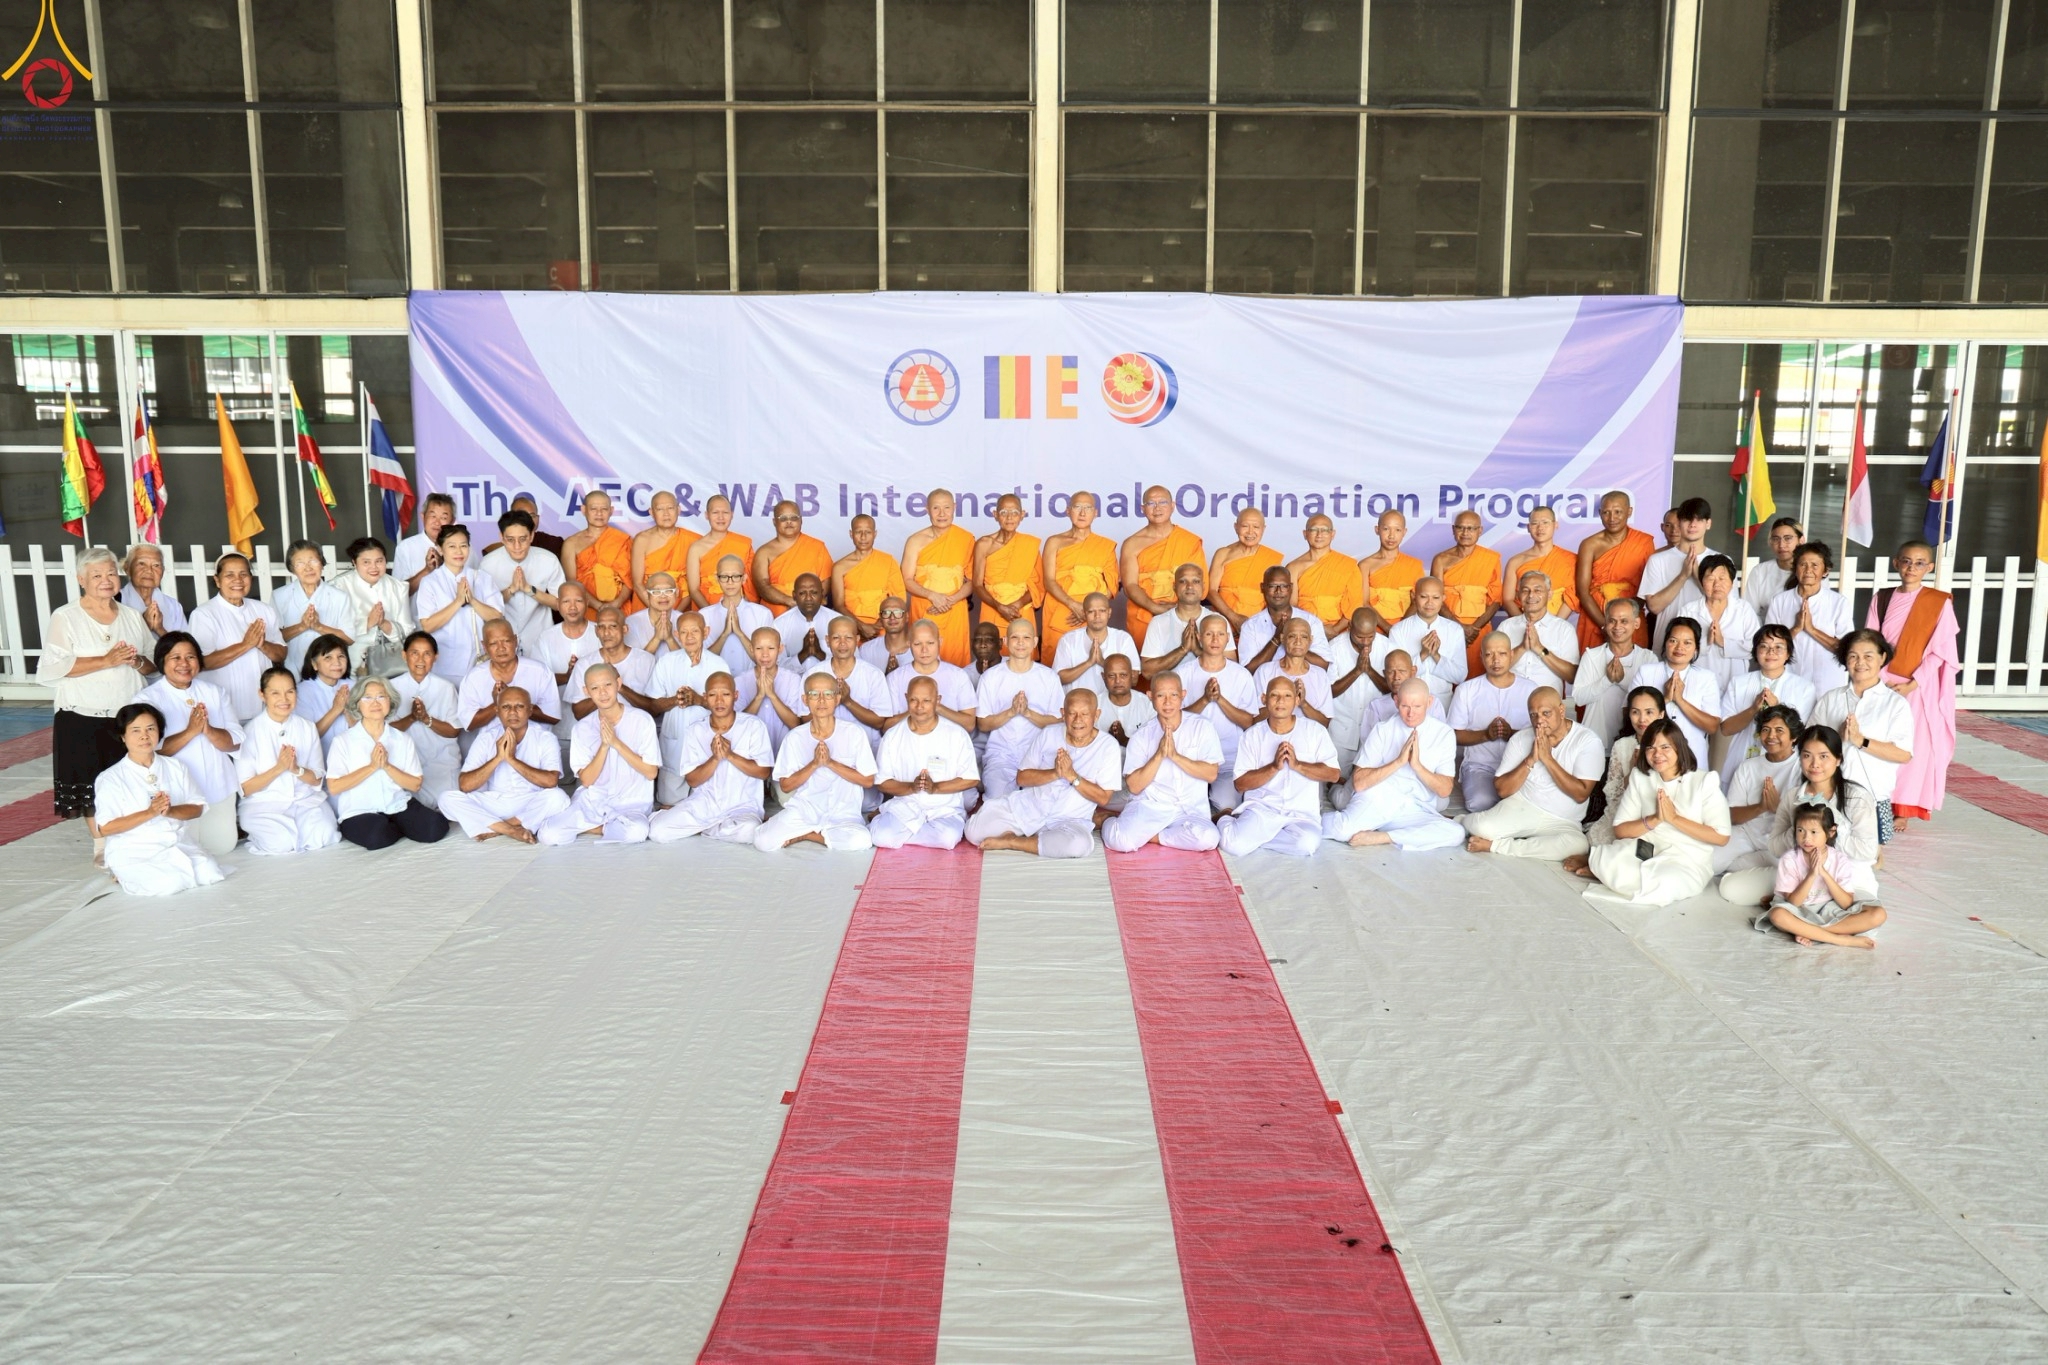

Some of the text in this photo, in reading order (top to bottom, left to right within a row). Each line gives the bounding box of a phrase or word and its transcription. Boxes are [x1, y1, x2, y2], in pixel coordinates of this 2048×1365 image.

[452, 481, 536, 516] Th
[675, 483, 701, 517] &
[718, 483, 820, 517] WAB
[839, 482, 1147, 518] Intenaioal
[1175, 481, 1420, 518] Ordination
[1438, 484, 1602, 528] Progra
